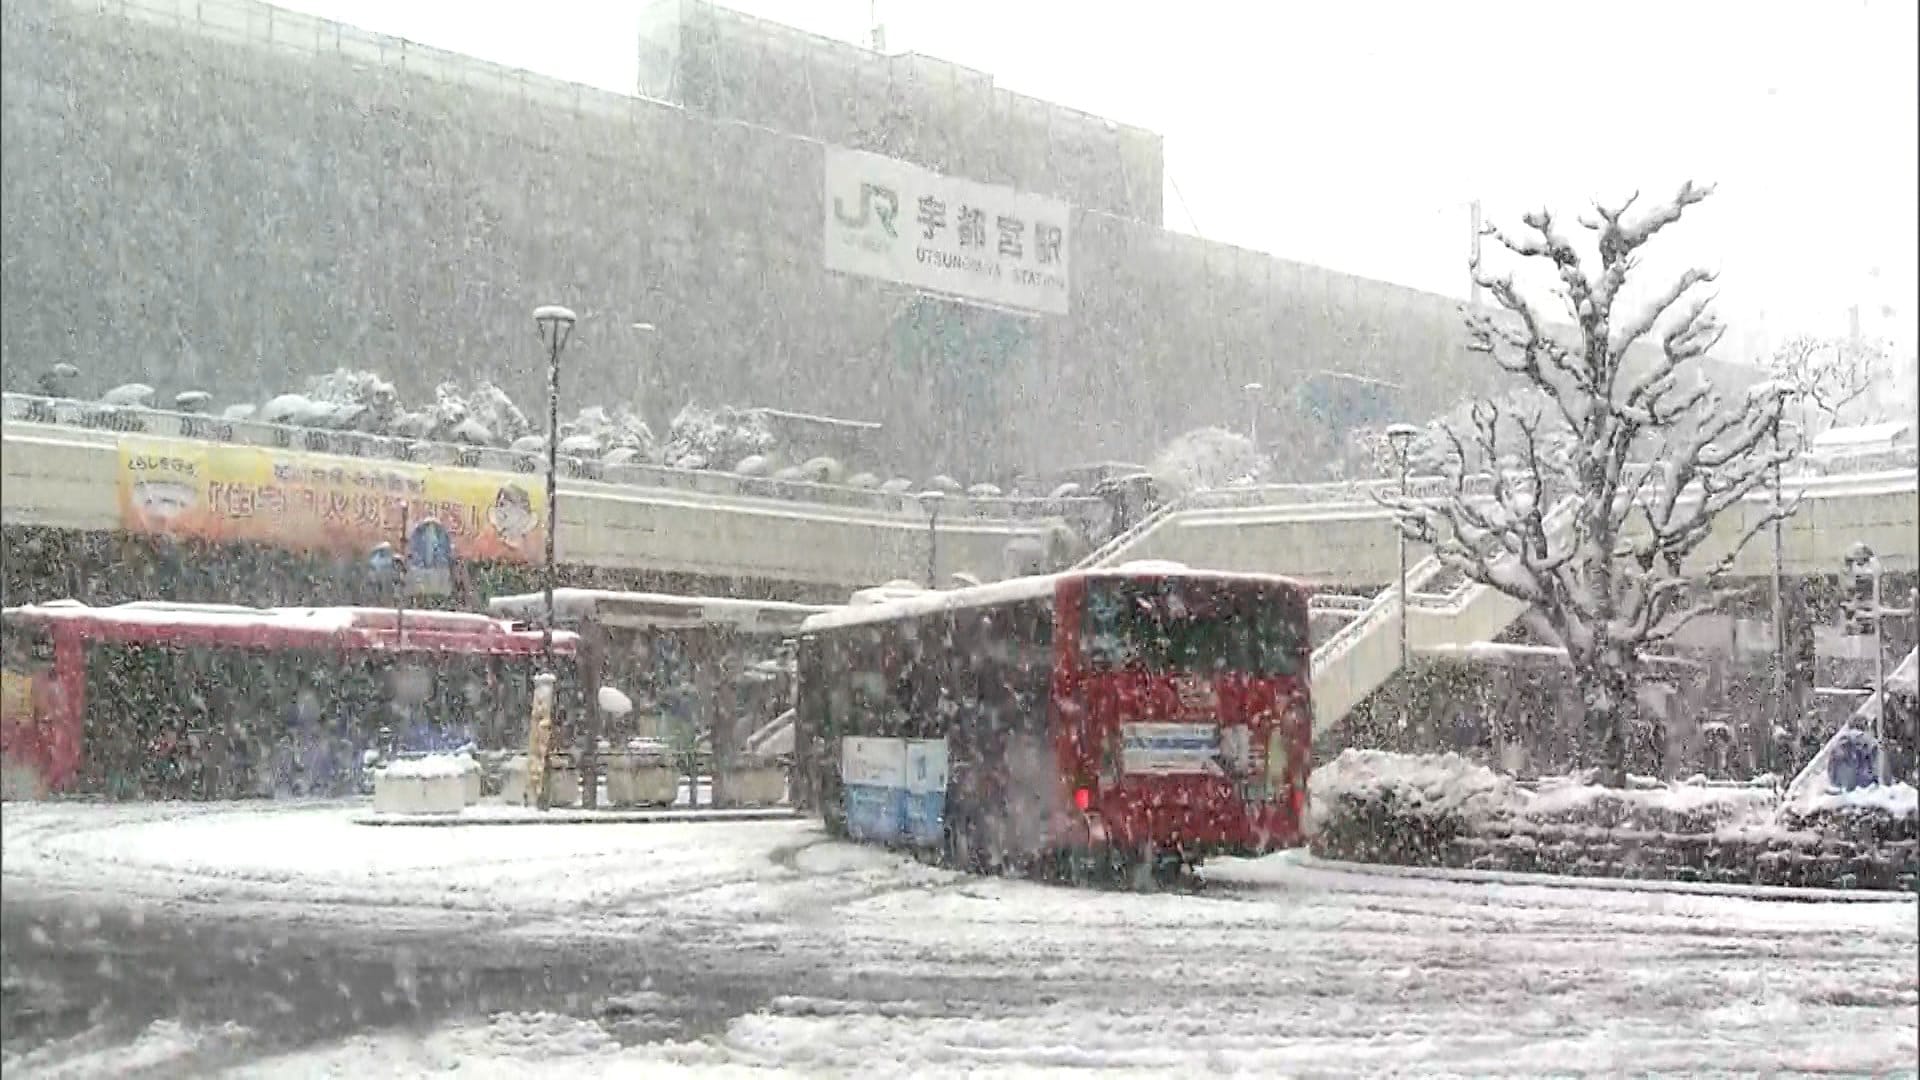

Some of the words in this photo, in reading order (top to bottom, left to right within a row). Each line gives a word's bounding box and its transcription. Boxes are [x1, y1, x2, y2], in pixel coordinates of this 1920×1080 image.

[834, 183, 898, 238] JR
[917, 195, 1063, 264] 宇都宮駅
